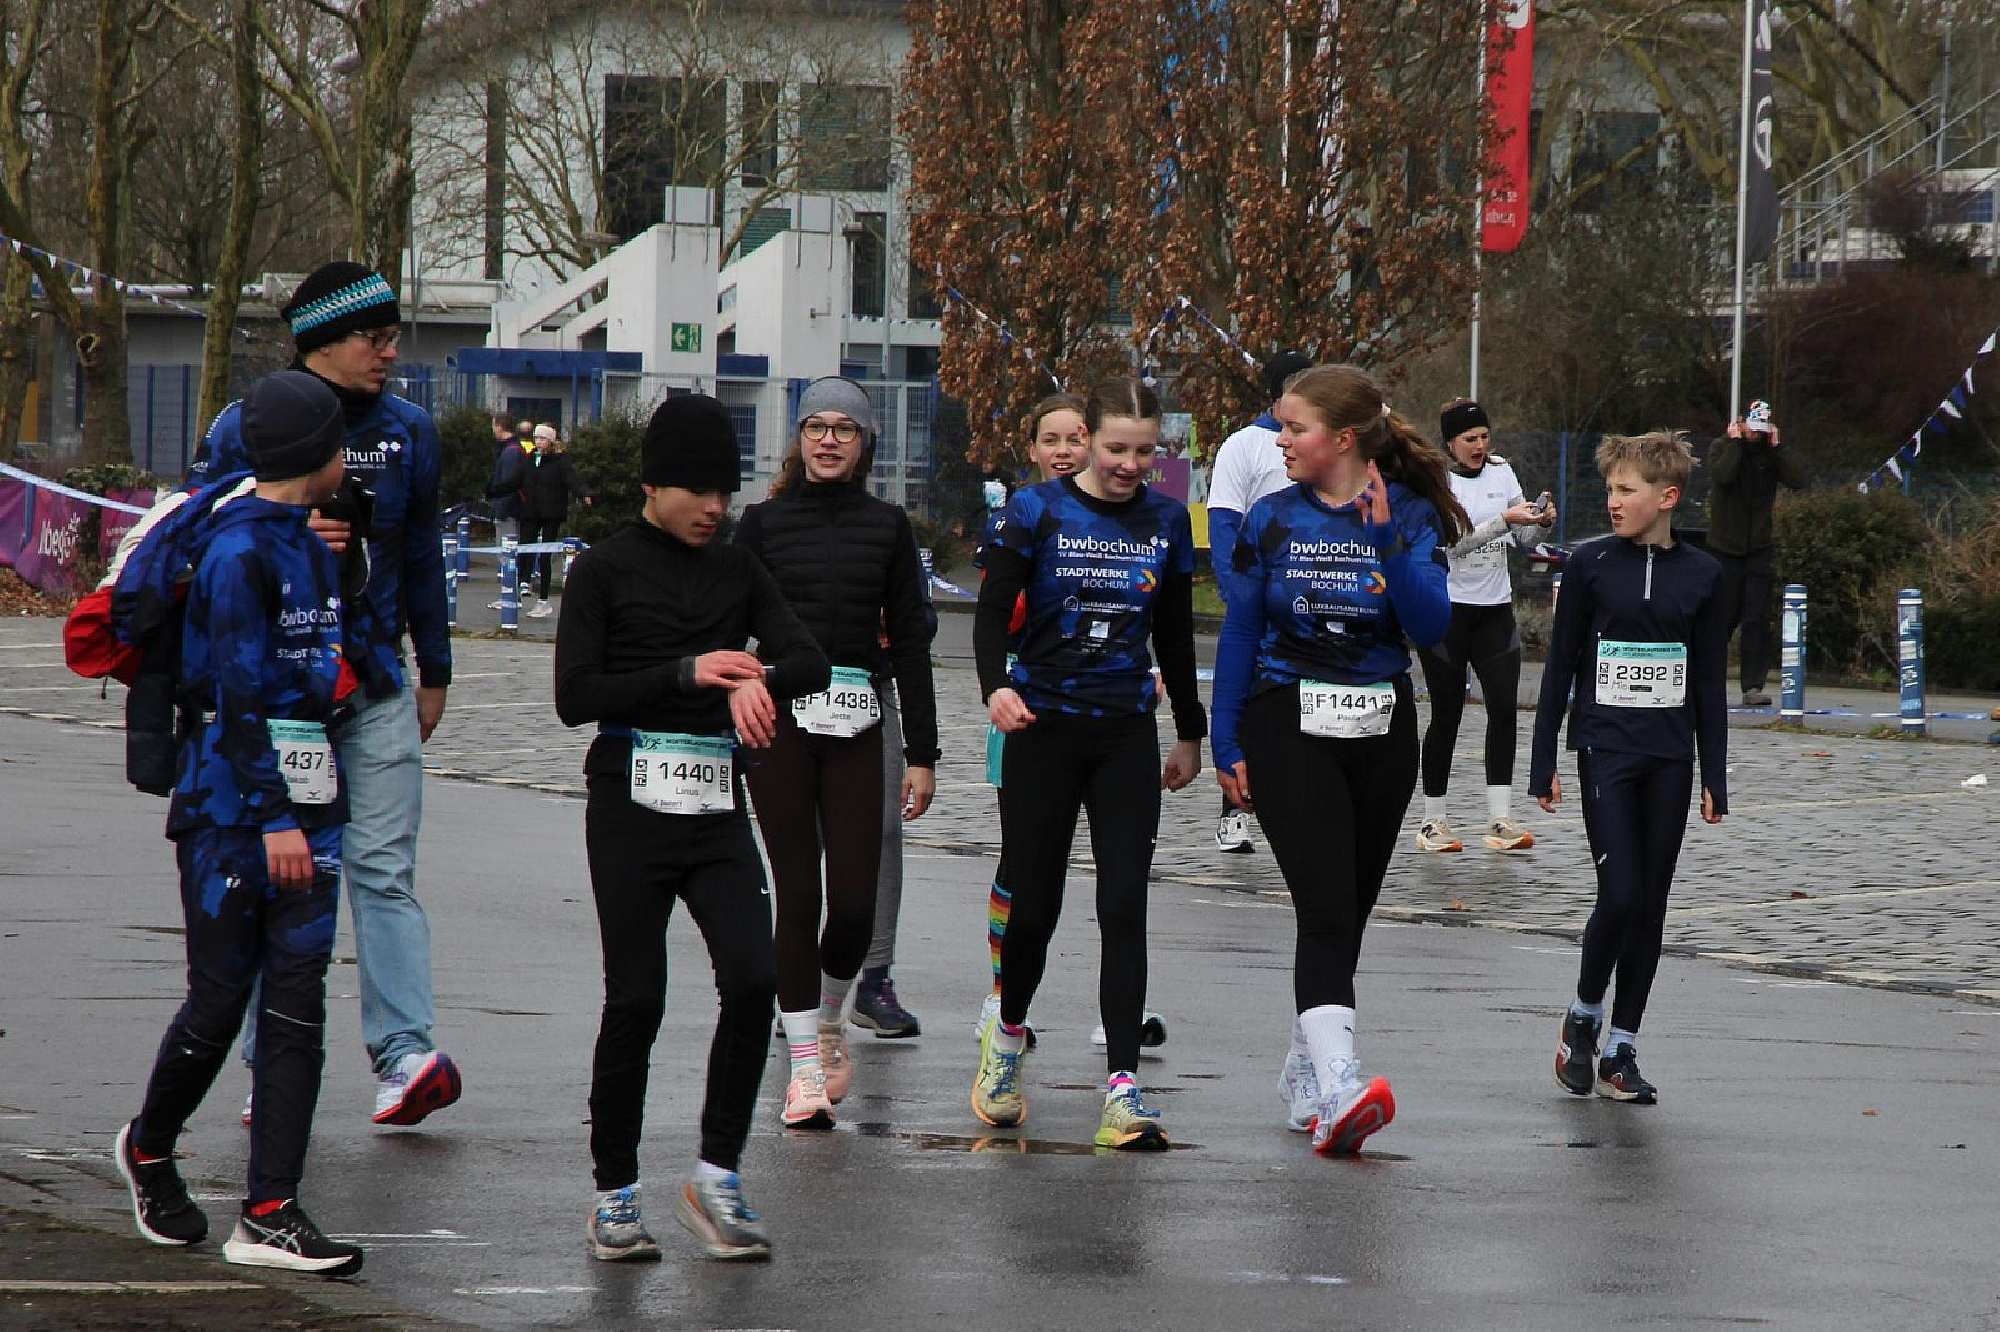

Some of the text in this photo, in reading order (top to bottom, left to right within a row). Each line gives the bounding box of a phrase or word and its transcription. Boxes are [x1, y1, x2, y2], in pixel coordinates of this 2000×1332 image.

[1057, 533, 1156, 557] bwbochum
[1290, 539, 1376, 557] bwbochu
[1056, 567, 1130, 579] STADTWERKE
[1286, 570, 1358, 581] STADTWERKE
[1082, 579, 1130, 590] BOCHUM
[1311, 580, 1359, 592] BOCHUM
[1616, 665, 1667, 681] 2392
[808, 690, 869, 710] F1438
[1316, 692, 1378, 710] F1441
[657, 761, 714, 784] 1440
[675, 785, 700, 797] Linus
